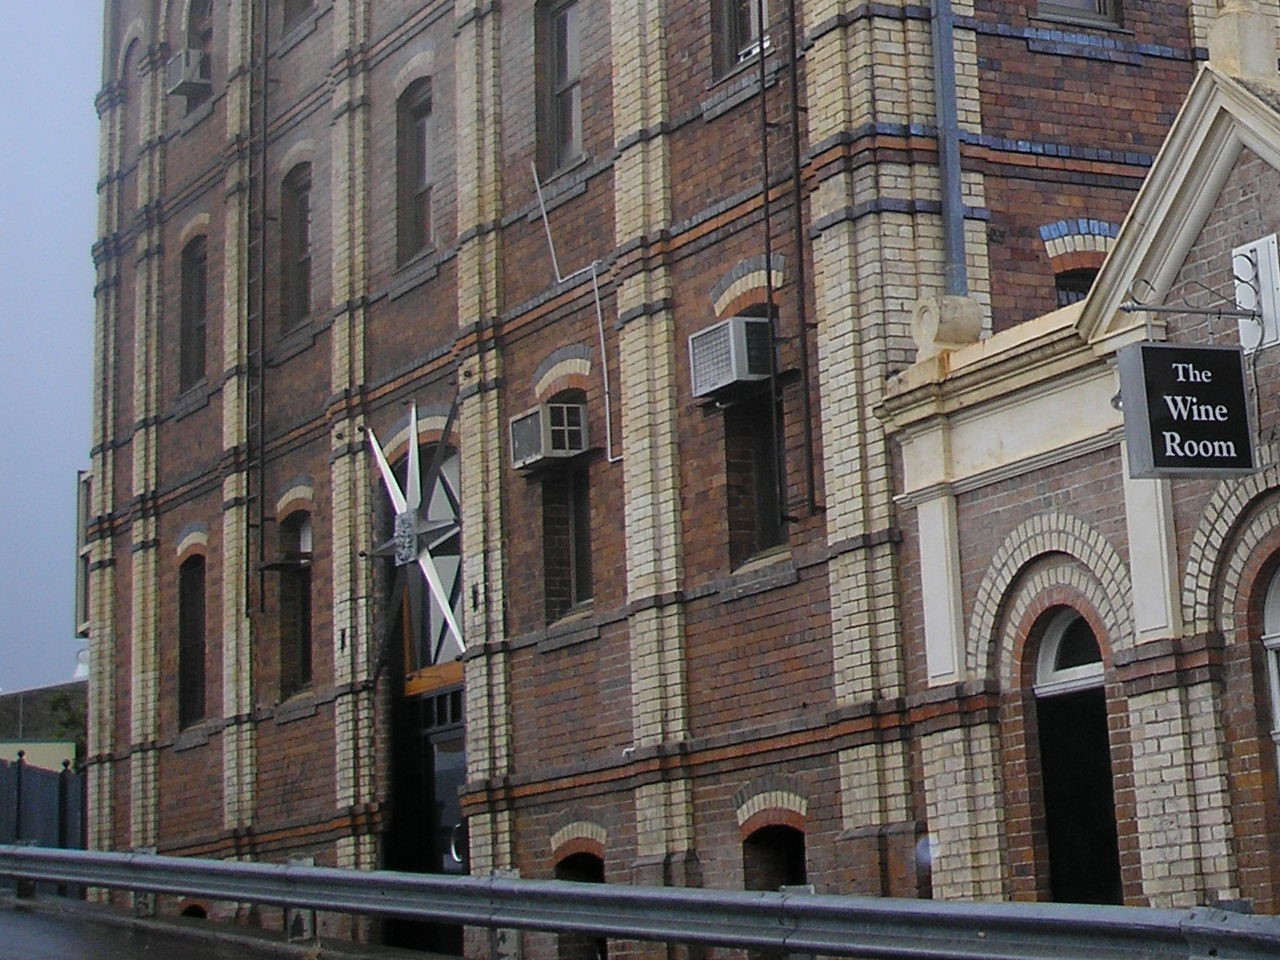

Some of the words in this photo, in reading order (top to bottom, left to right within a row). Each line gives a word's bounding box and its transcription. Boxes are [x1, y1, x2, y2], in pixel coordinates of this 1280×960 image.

[1172, 363, 1212, 383] The
[1163, 395, 1229, 422] Wine
[1162, 431, 1237, 457] Room
